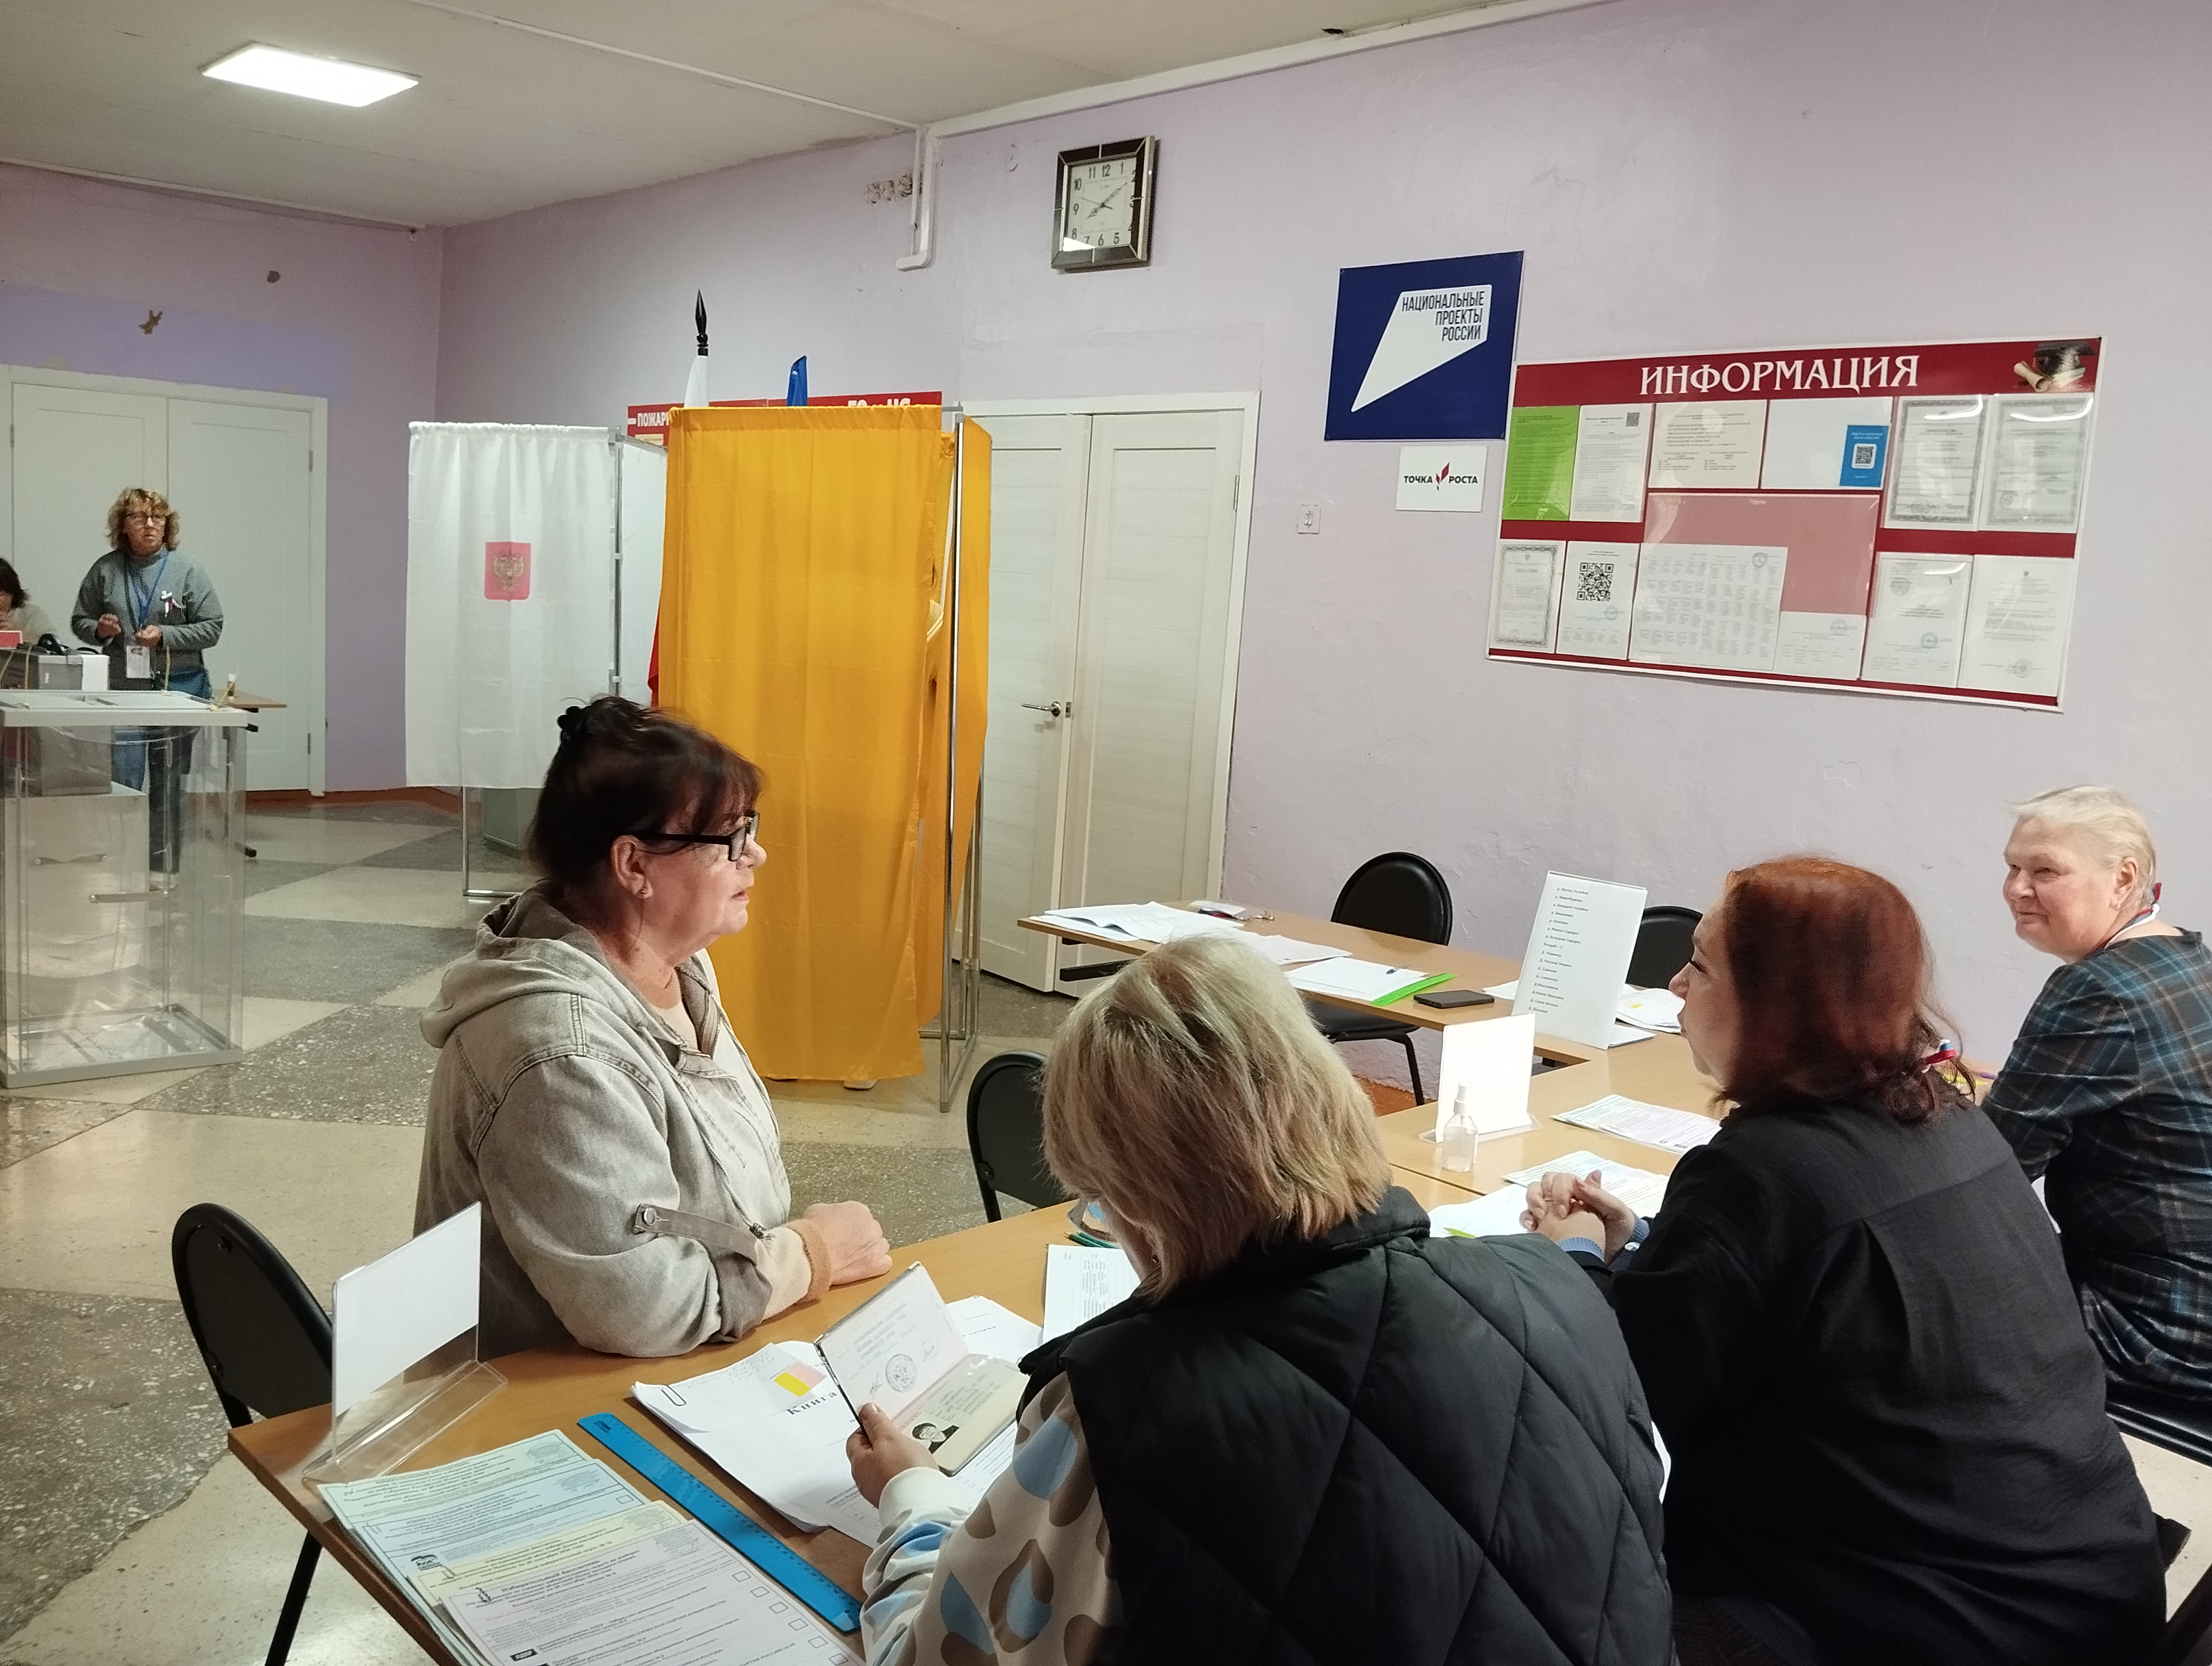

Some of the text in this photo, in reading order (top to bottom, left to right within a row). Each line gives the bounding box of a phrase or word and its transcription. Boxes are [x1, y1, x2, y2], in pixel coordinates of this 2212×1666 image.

[1089, 168, 1096, 179] 11
[1102, 164, 1110, 177] 12
[1121, 162, 1123, 174] 1
[1074, 179, 1082, 190] 10
[1073, 203, 1079, 215] 9
[1098, 234, 1104, 246] 6
[1114, 232, 1119, 245] 5
[1401, 291, 1485, 312] НАЦИОНАЛЬНЫЕ
[1435, 308, 1483, 326] ПРОЕКТЫ
[1442, 325, 1481, 342] РОССИИ
[1639, 355, 1920, 395] ИНФОРМАЦИЯ
[1404, 475, 1478, 484] ТОЧКА РОСТА
[786, 1390, 838, 1416] Книга
